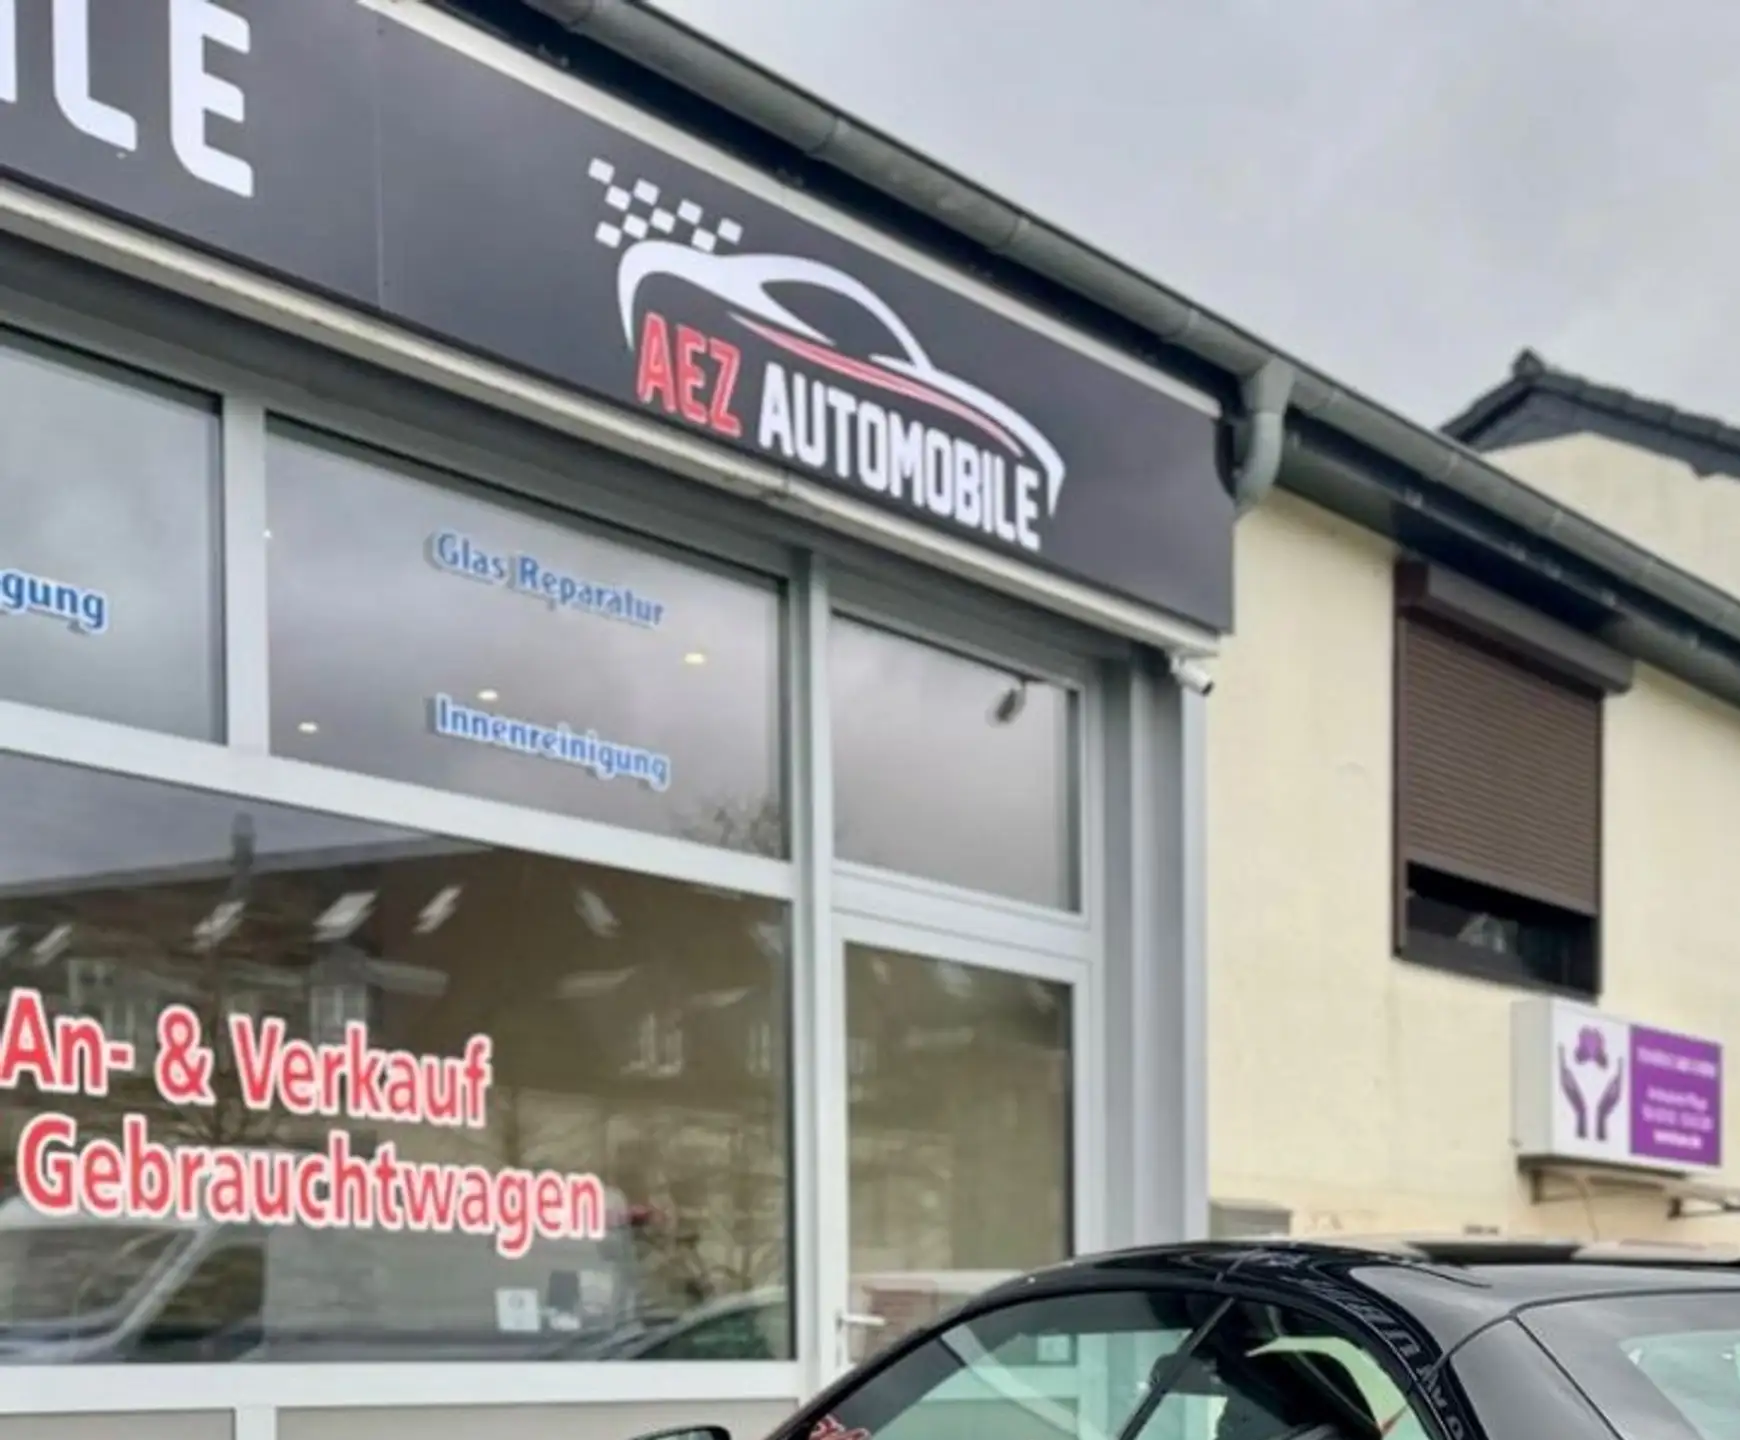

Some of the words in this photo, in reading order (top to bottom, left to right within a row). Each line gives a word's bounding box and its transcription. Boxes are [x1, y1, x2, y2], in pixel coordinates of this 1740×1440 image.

[636, 312, 742, 438] AEZ
[758, 362, 1040, 551] AUTOMOBILE
[438, 533, 505, 579] Glas
[519, 555, 664, 626] Reparatur
[439, 698, 669, 786] Innenreinigung
[0, 992, 132, 1091] An-
[158, 1008, 212, 1103] &
[231, 1016, 490, 1126] Verkauf
[20, 1115, 603, 1255] Gebrauchtwagen
